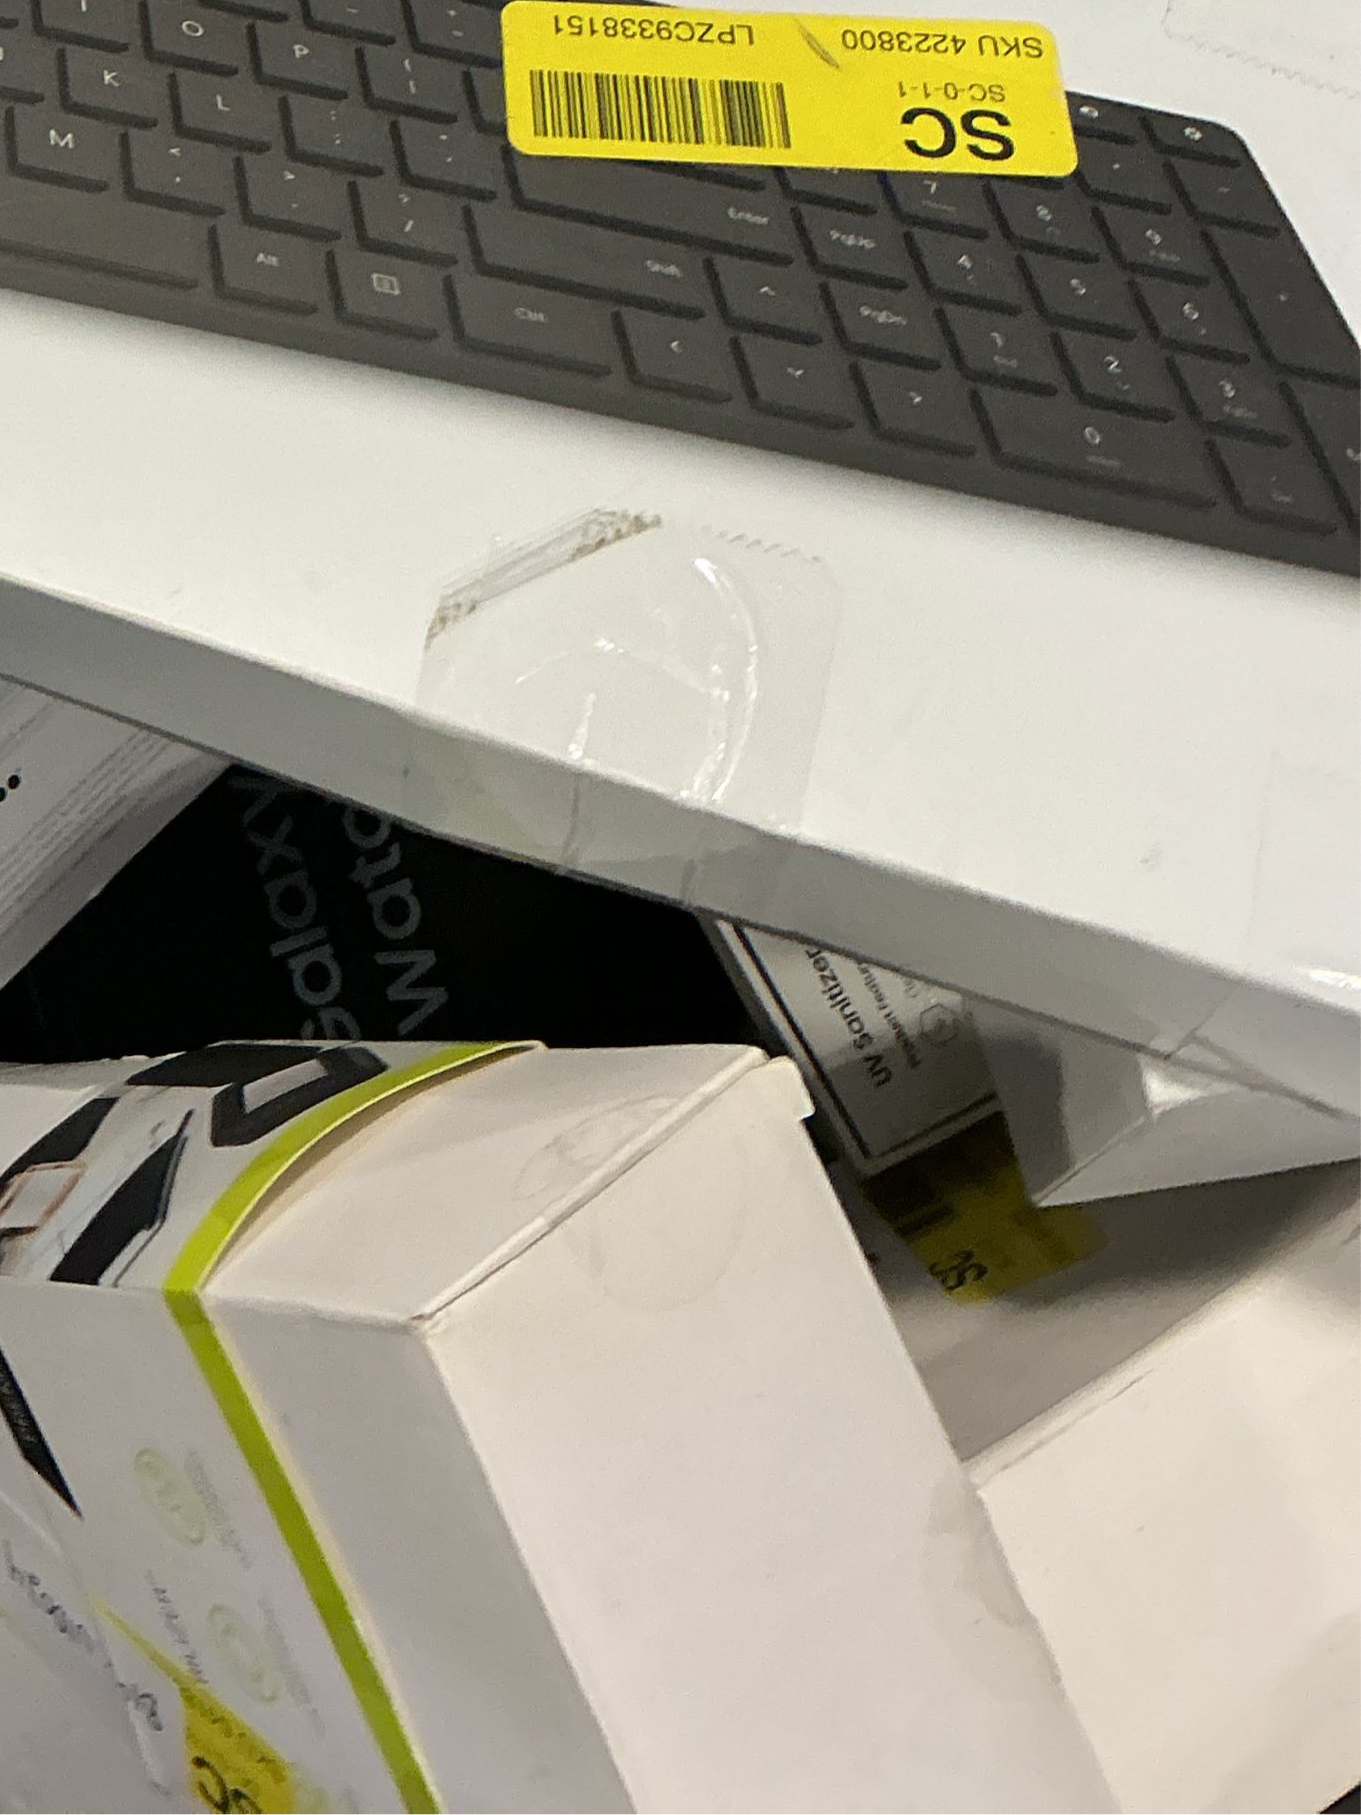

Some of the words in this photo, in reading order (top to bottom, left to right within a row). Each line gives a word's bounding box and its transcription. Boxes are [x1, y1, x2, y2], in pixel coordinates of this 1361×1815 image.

[181, 20, 204, 37] O
[553, 14, 755, 46] LPZC9338151
[292, 43, 310, 59] P
[841, 27, 965, 55] 4223800
[978, 35, 1043, 59] SKU
[103, 69, 119, 87] K
[215, 94, 230, 112] L
[897, 81, 1006, 103] SC-0-1-1
[49, 129, 74, 149] M
[902, 107, 1015, 161] SC
[727, 206, 769, 225] Enter
[806, 948, 874, 1050] Sanitizer
[863, 1054, 892, 1089] UV
